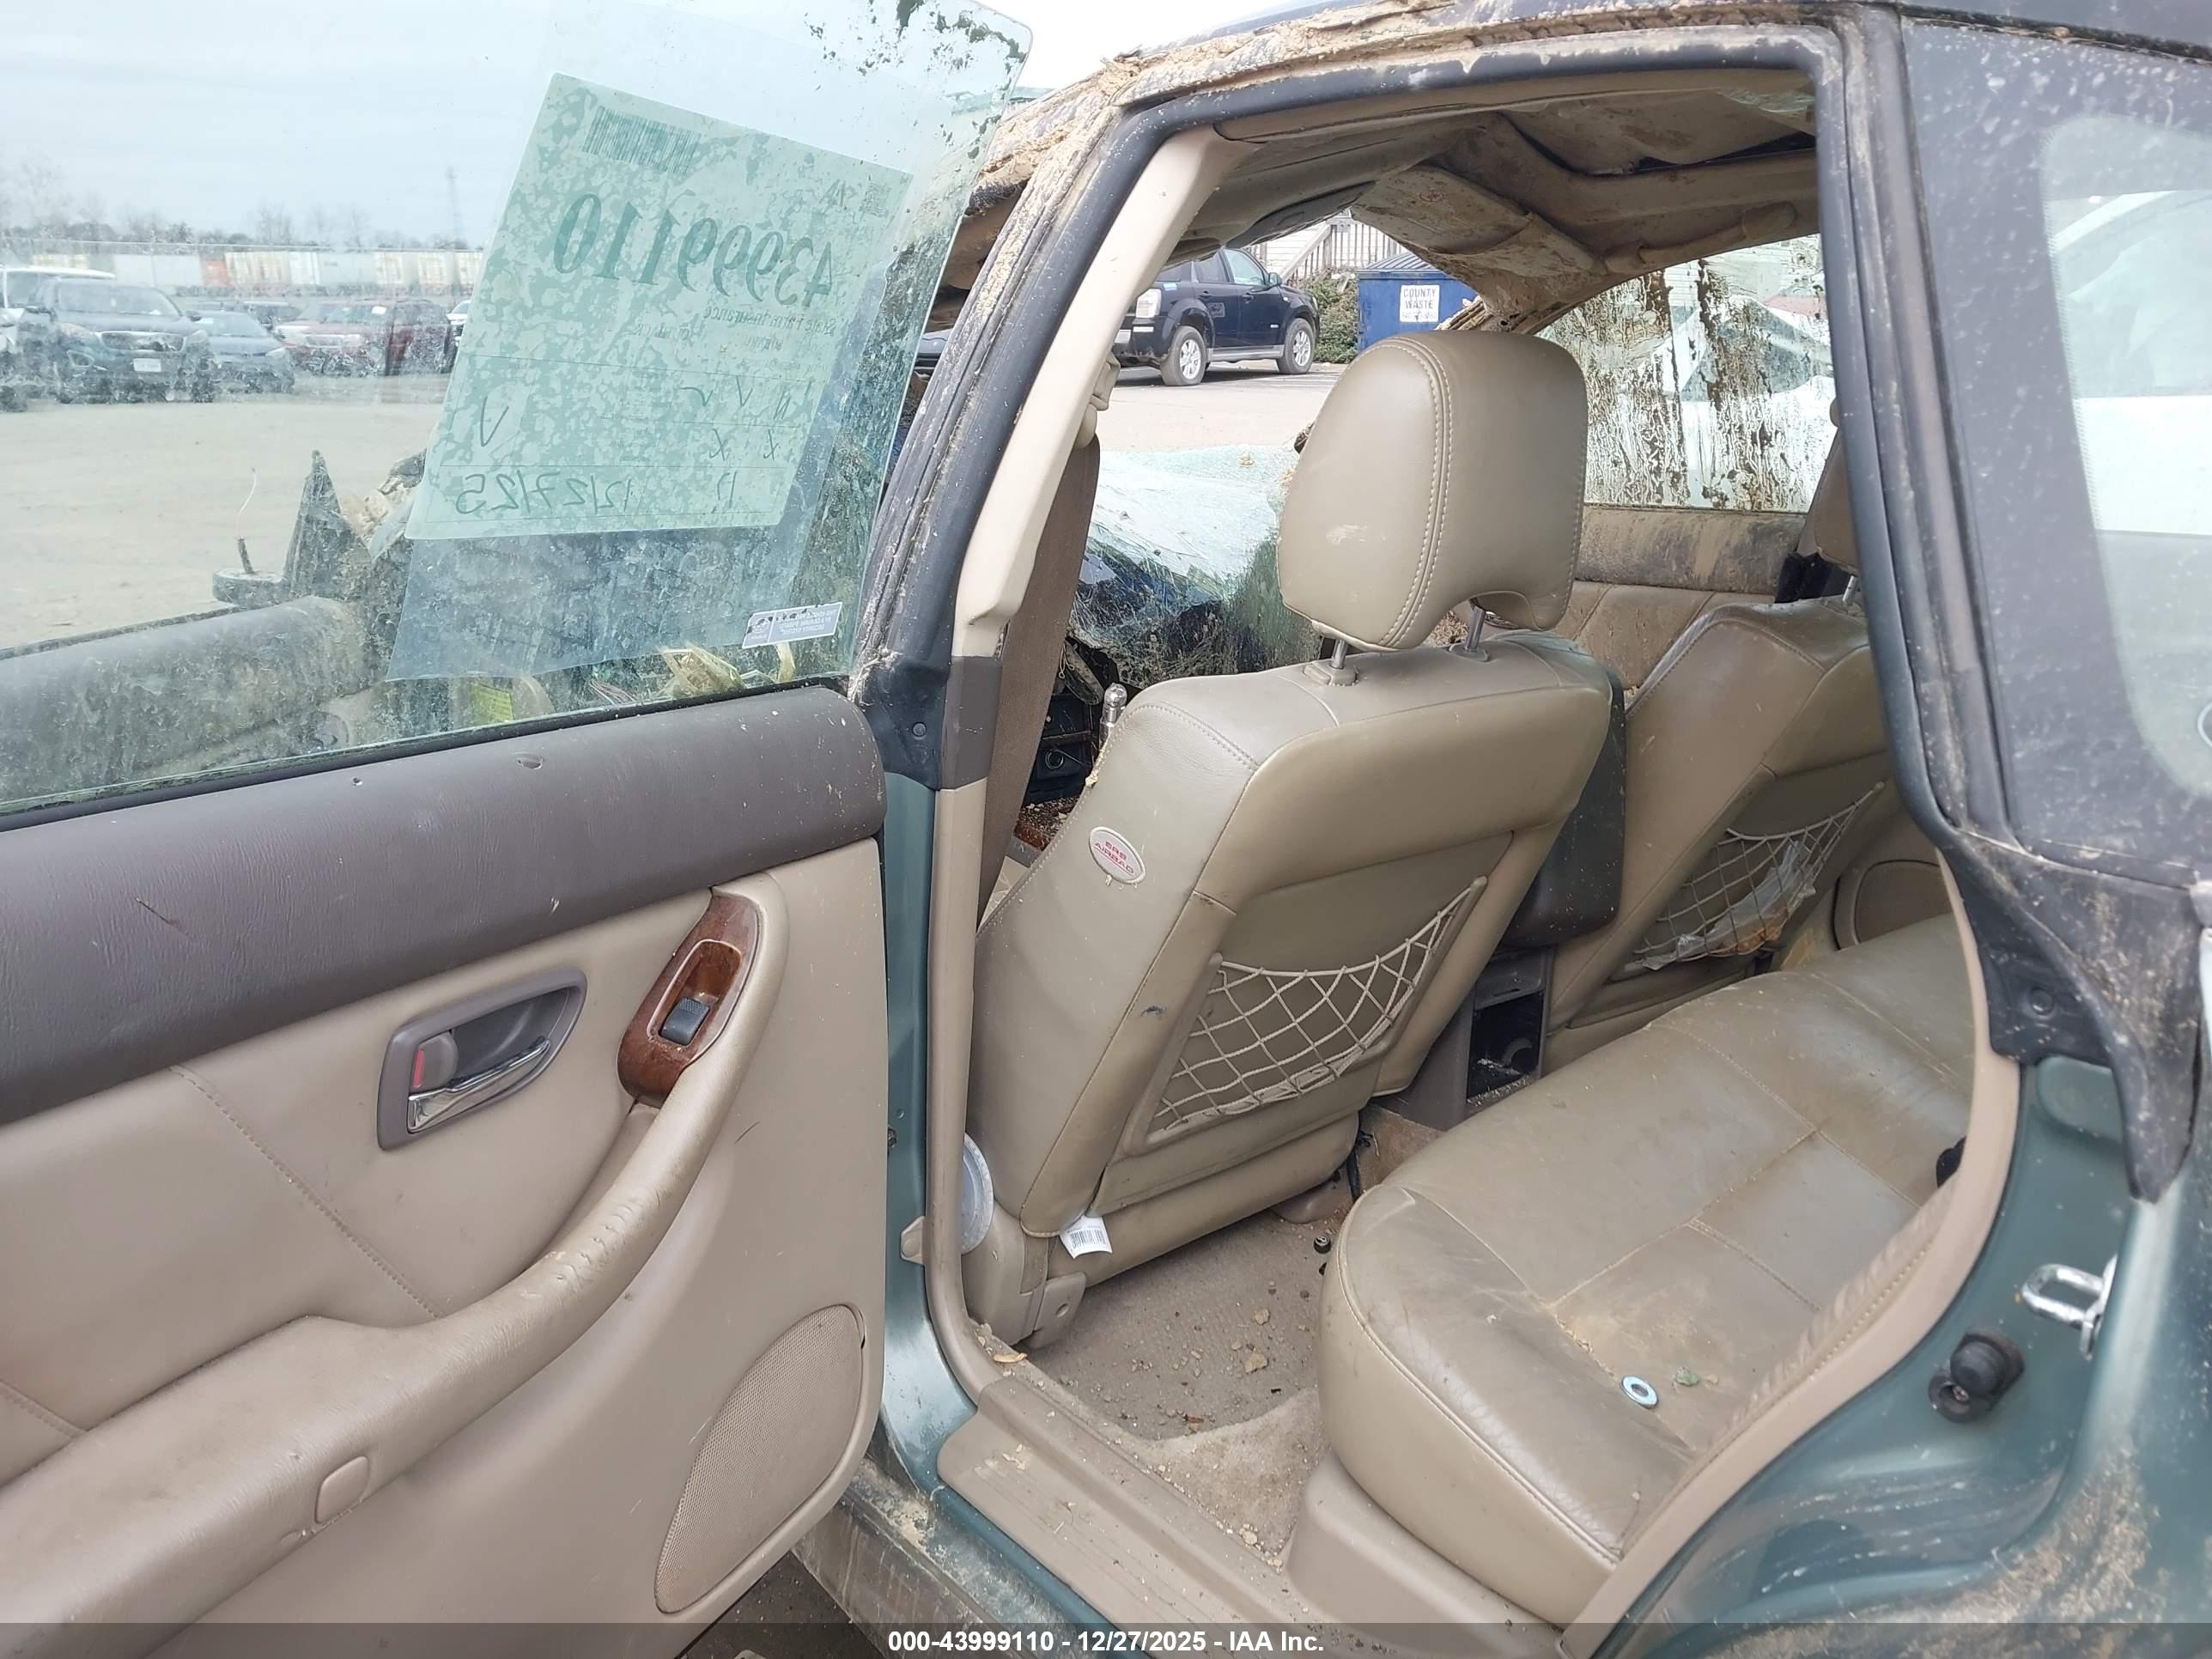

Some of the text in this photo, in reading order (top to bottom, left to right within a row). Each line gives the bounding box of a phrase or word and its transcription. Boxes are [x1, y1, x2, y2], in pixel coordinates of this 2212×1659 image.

[1403, 288, 1437, 298] COUNTY
[1405, 300, 1434, 310] WASTE
[1095, 842, 1134, 873] AIRBAG
[1105, 841, 1127, 860] SRS
